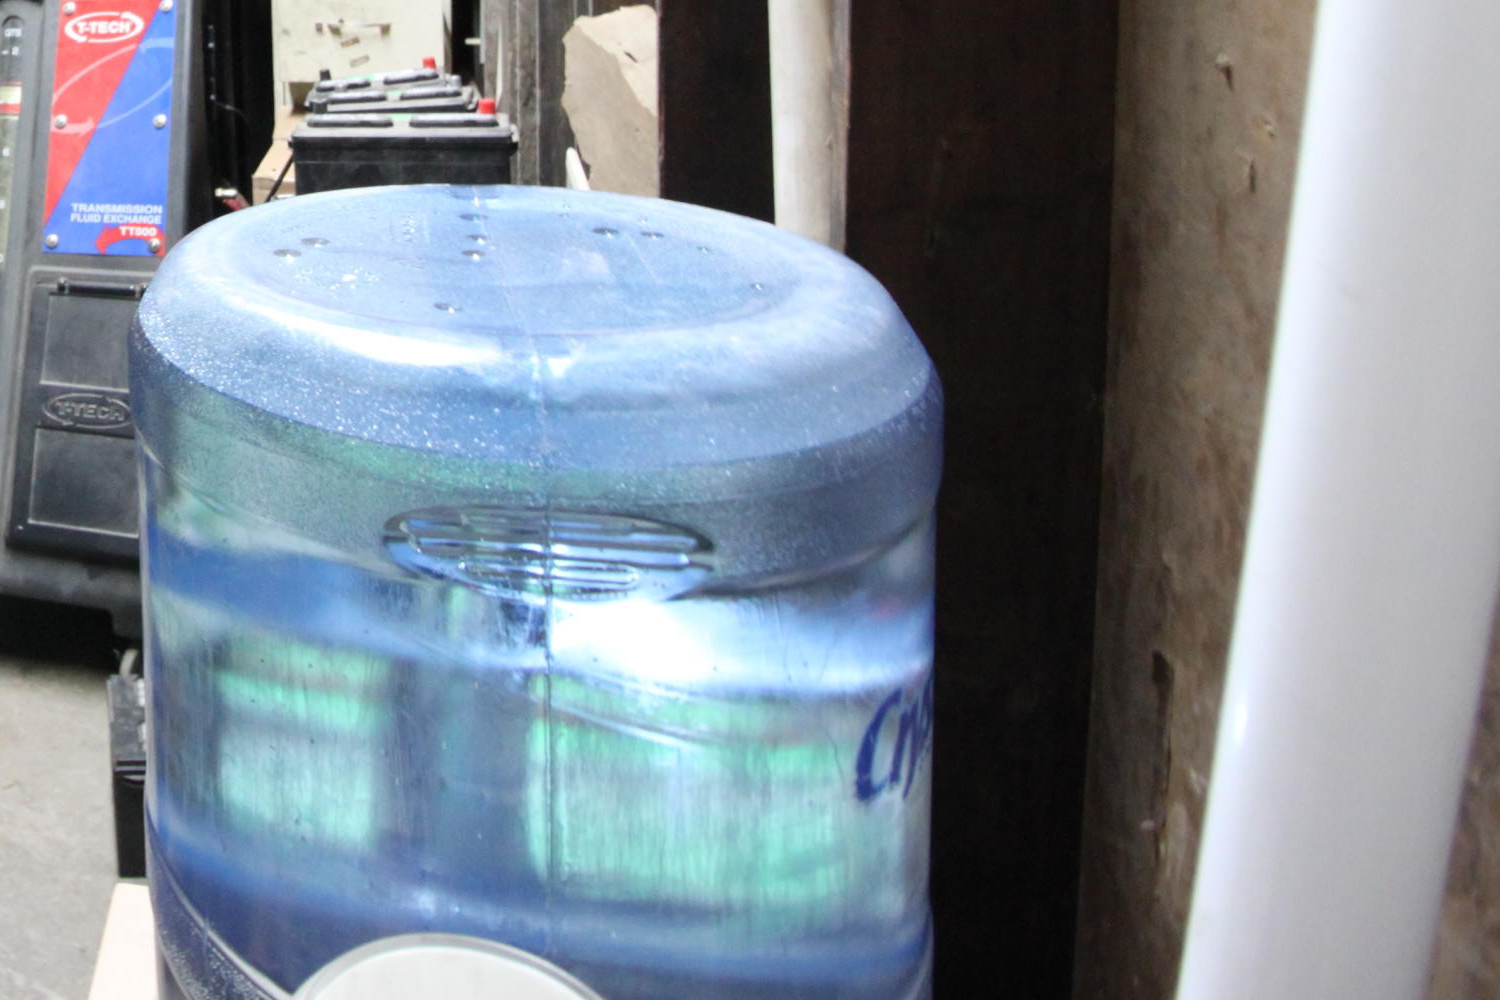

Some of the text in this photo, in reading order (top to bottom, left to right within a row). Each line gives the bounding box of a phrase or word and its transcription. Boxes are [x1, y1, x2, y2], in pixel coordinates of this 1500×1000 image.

[77, 20, 131, 34] T-TECH
[71, 203, 162, 214] TRANSMISSION
[70, 213, 161, 225] FLUID EXCHANGE
[55, 401, 125, 421] T-TECH
